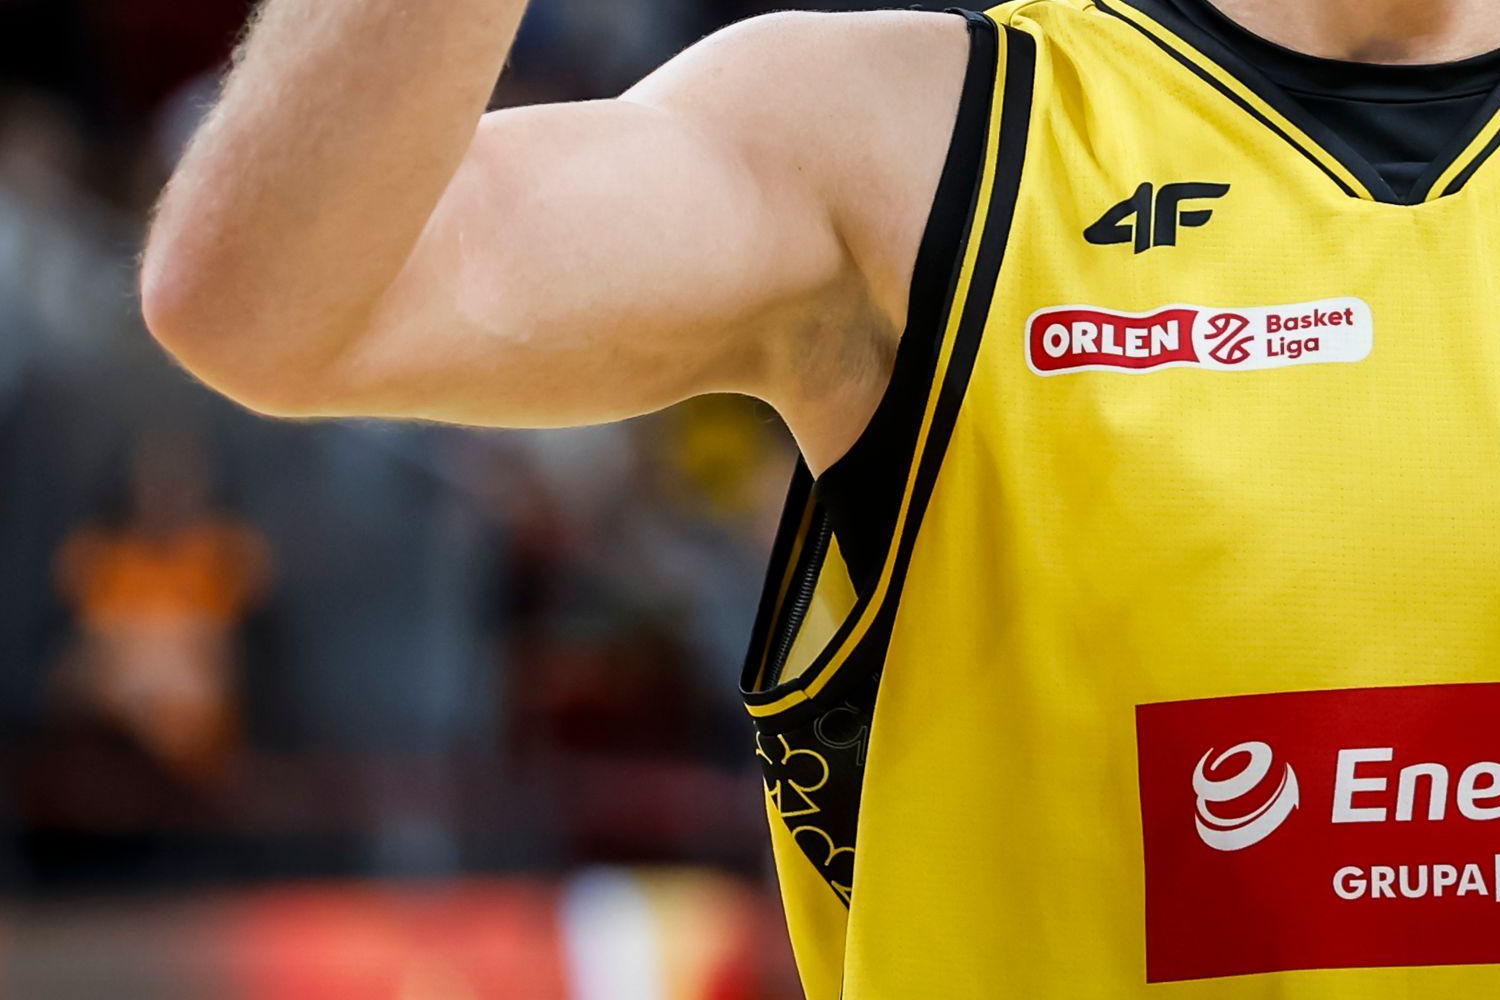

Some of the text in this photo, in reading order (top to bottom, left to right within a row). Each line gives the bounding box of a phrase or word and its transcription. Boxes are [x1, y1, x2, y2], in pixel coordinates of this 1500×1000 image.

[1083, 182, 1231, 254] 4F
[1042, 319, 1180, 357] ORLEN
[1266, 308, 1354, 333] Basket
[1266, 335, 1320, 358] Liga
[1333, 864, 1489, 899] GRUPA
